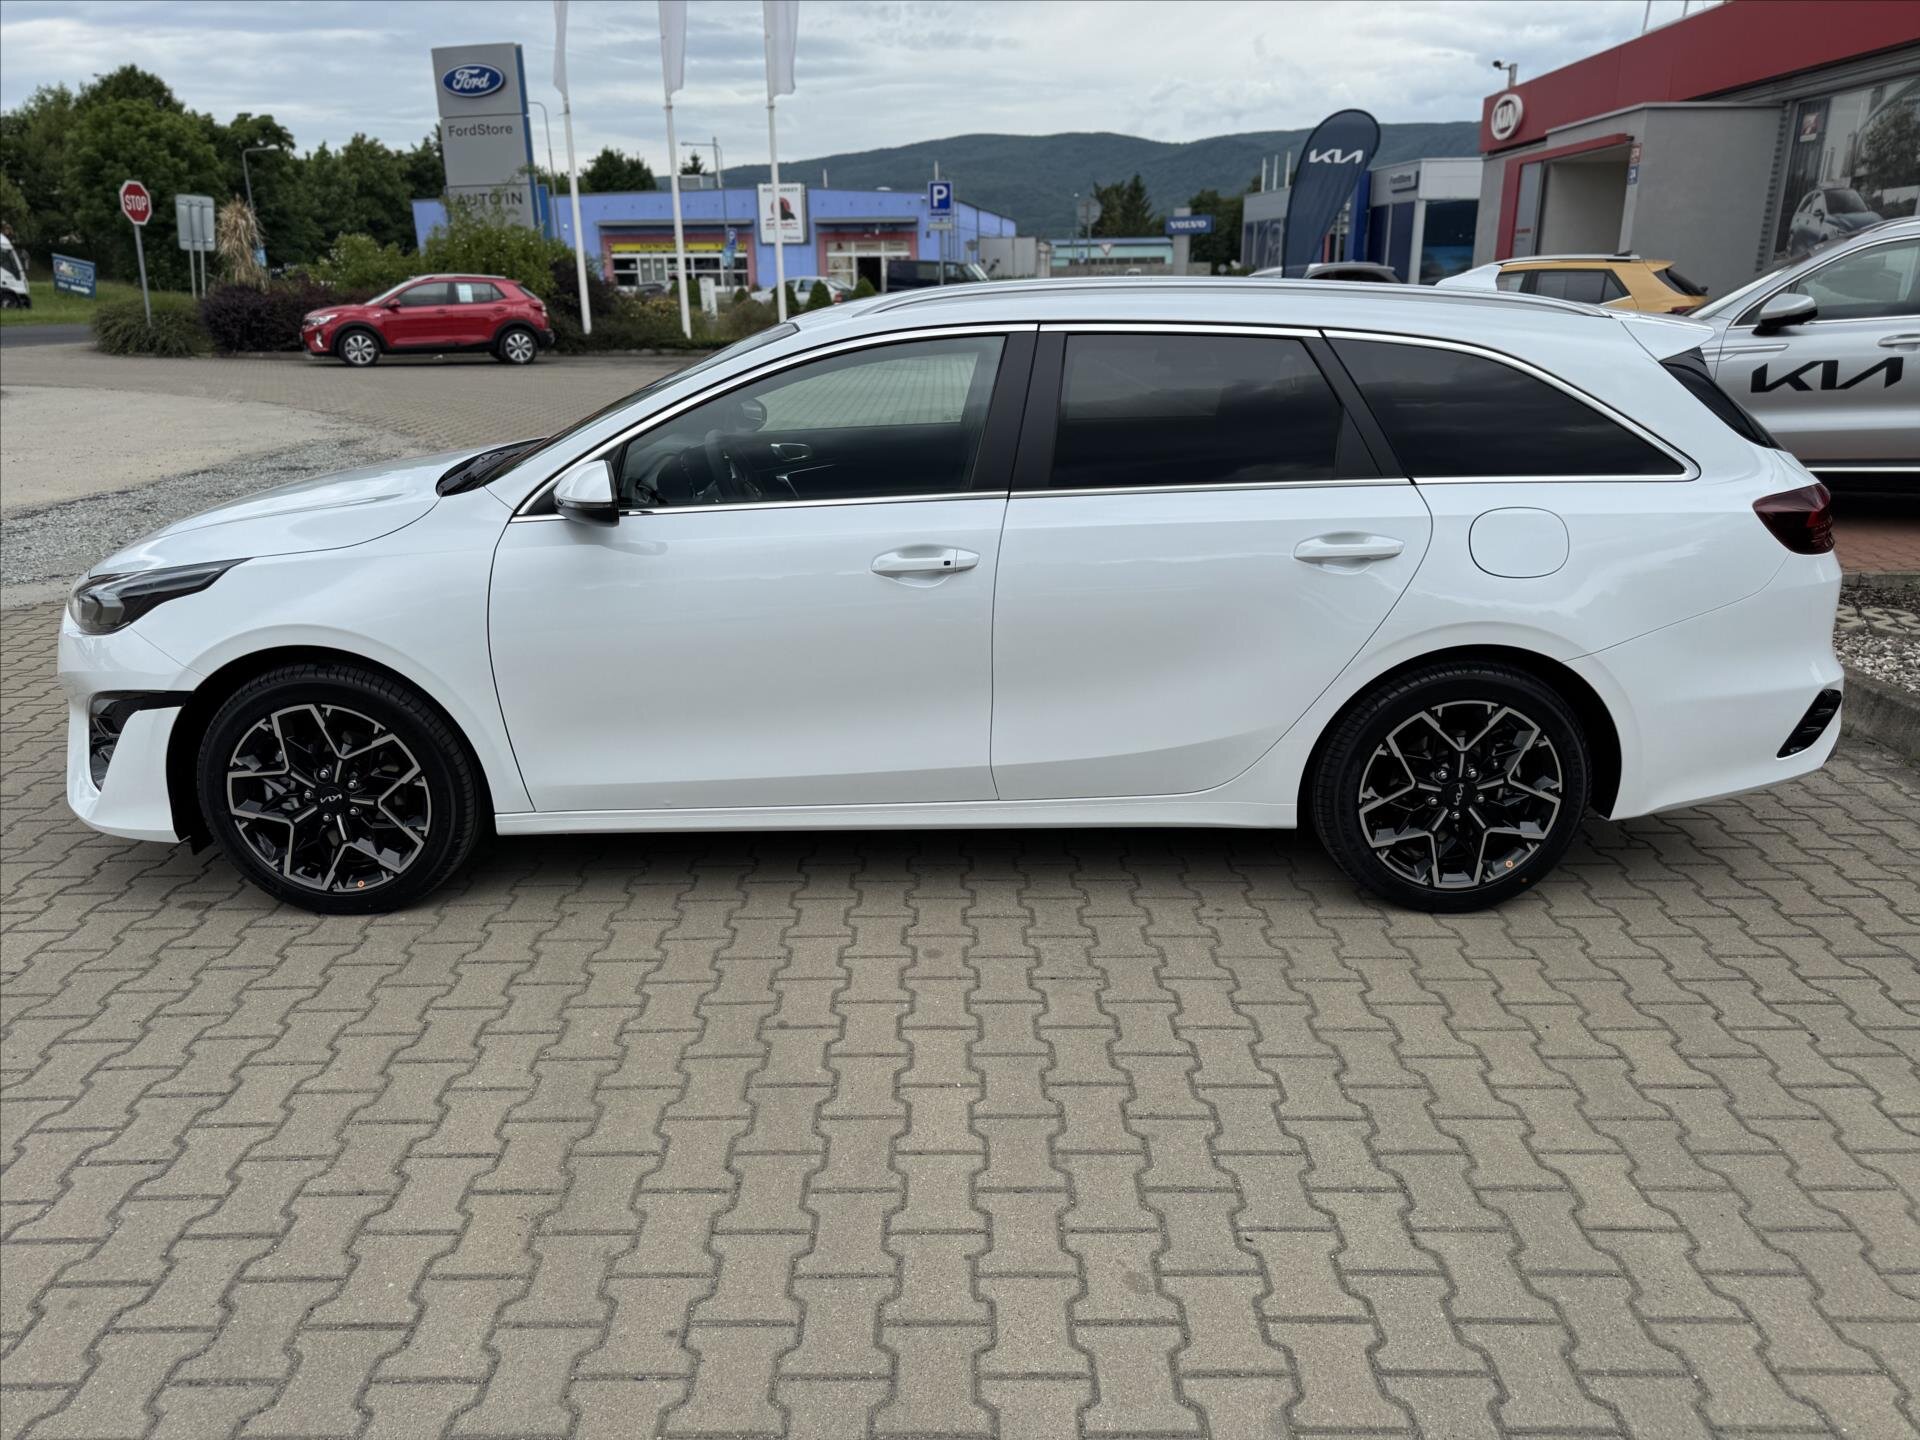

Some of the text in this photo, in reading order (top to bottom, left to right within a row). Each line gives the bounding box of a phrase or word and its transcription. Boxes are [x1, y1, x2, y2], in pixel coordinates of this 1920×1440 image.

[452, 69, 490, 90] Ford
[448, 123, 513, 137] FordStore
[1309, 148, 1364, 164] KIA
[125, 195, 147, 211] STOP
[457, 191, 522, 206] AUTO IN
[932, 185, 948, 208] P
[1170, 220, 1207, 229] VOLVO
[1750, 356, 1904, 393] KIA
